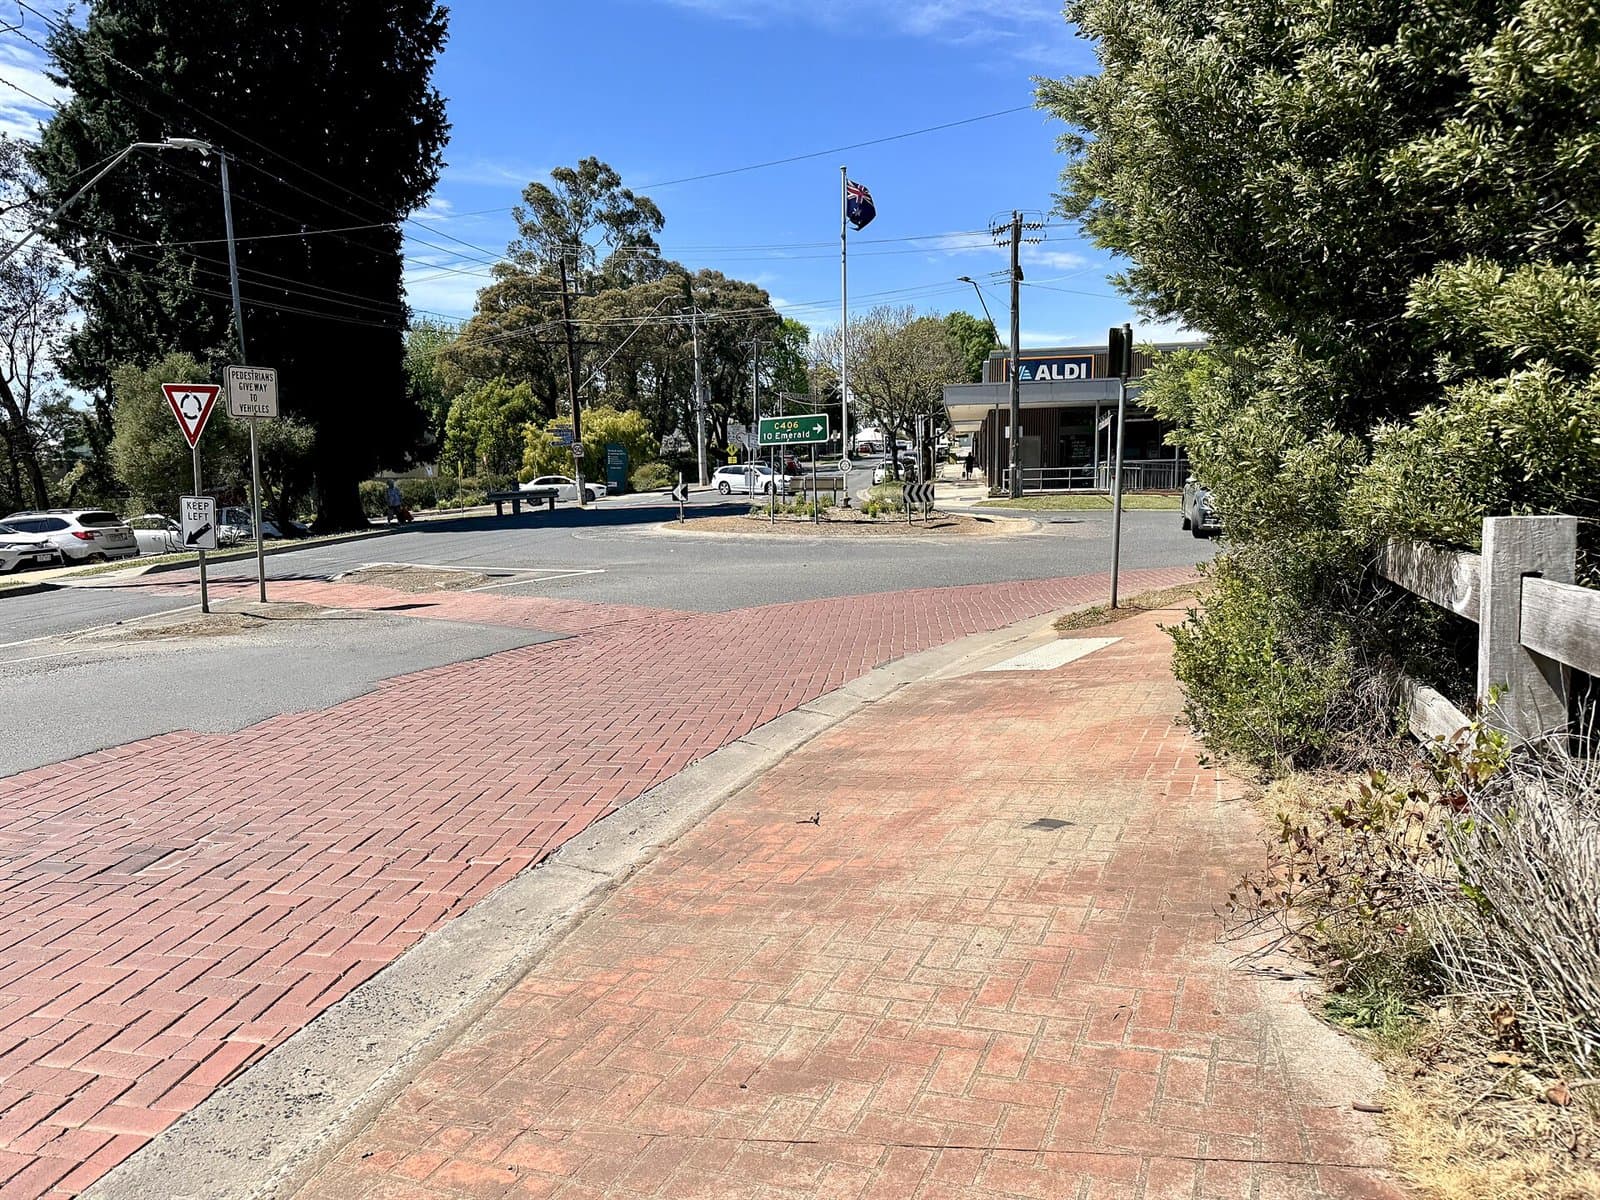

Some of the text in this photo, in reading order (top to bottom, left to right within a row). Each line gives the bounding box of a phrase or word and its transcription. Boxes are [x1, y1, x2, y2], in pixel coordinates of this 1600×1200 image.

[231, 370, 274, 382] PEDESTRIANS
[1034, 363, 1087, 381] ALDI
[238, 382, 267, 393] GIVE WAY
[250, 393, 258, 402] TO
[240, 403, 270, 414] VEHICLES
[774, 421, 799, 430] C406
[763, 432, 773, 441] 10
[774, 430, 810, 440] Emerald
[186, 501, 209, 511] KEEP
[187, 511, 208, 521] LEFT
